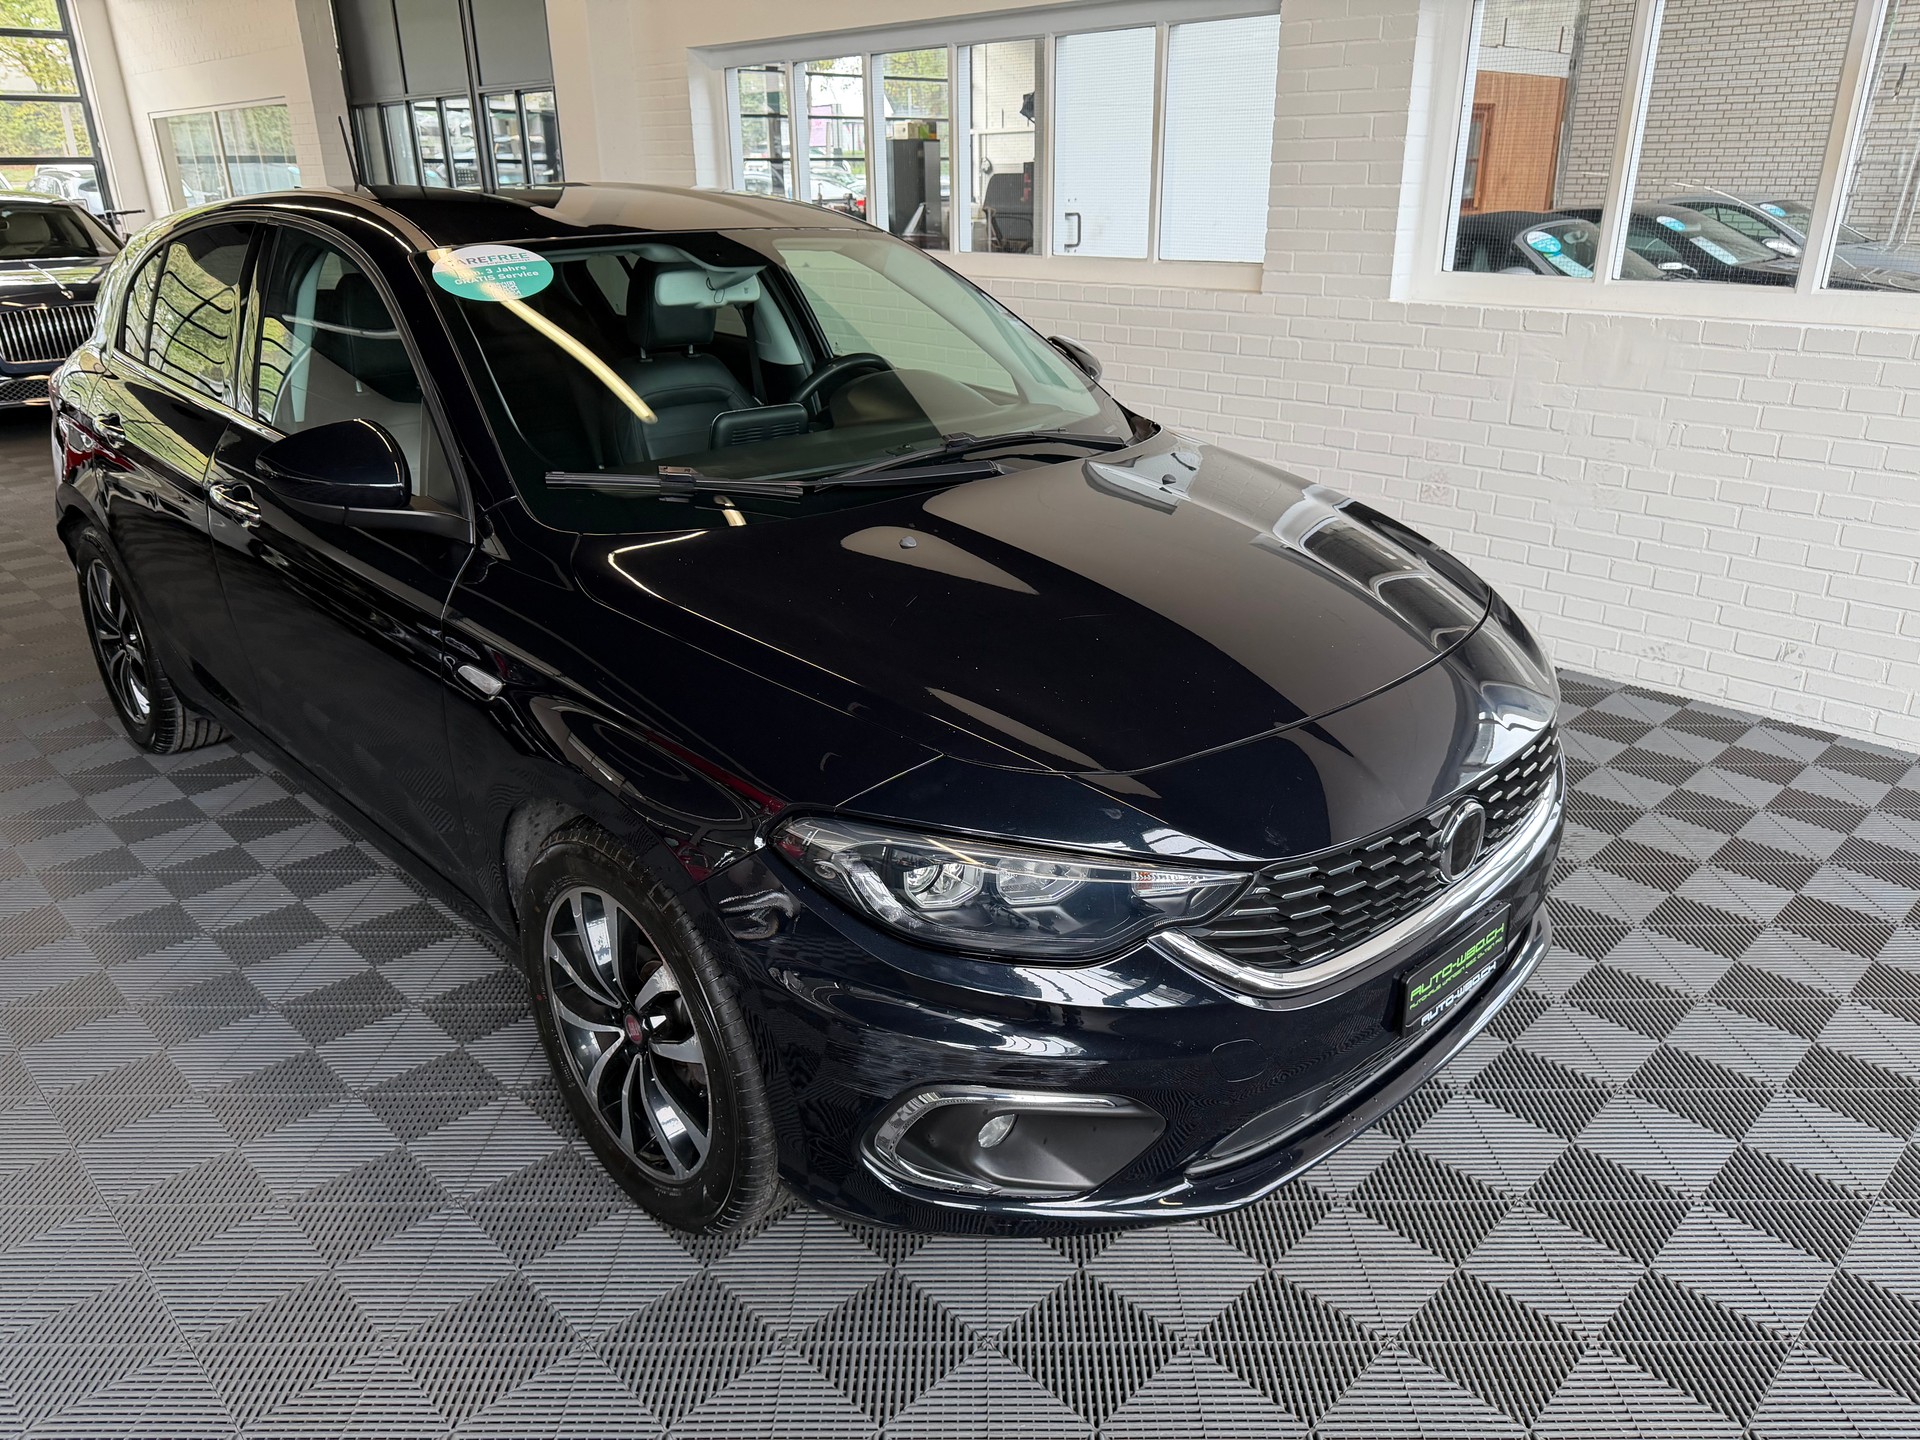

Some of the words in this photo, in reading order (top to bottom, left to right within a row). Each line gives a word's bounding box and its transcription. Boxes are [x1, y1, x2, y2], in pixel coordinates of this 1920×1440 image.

[455, 252, 530, 265] AREFREE
[496, 265, 527, 273] Jahre
[497, 270, 539, 280] Service
